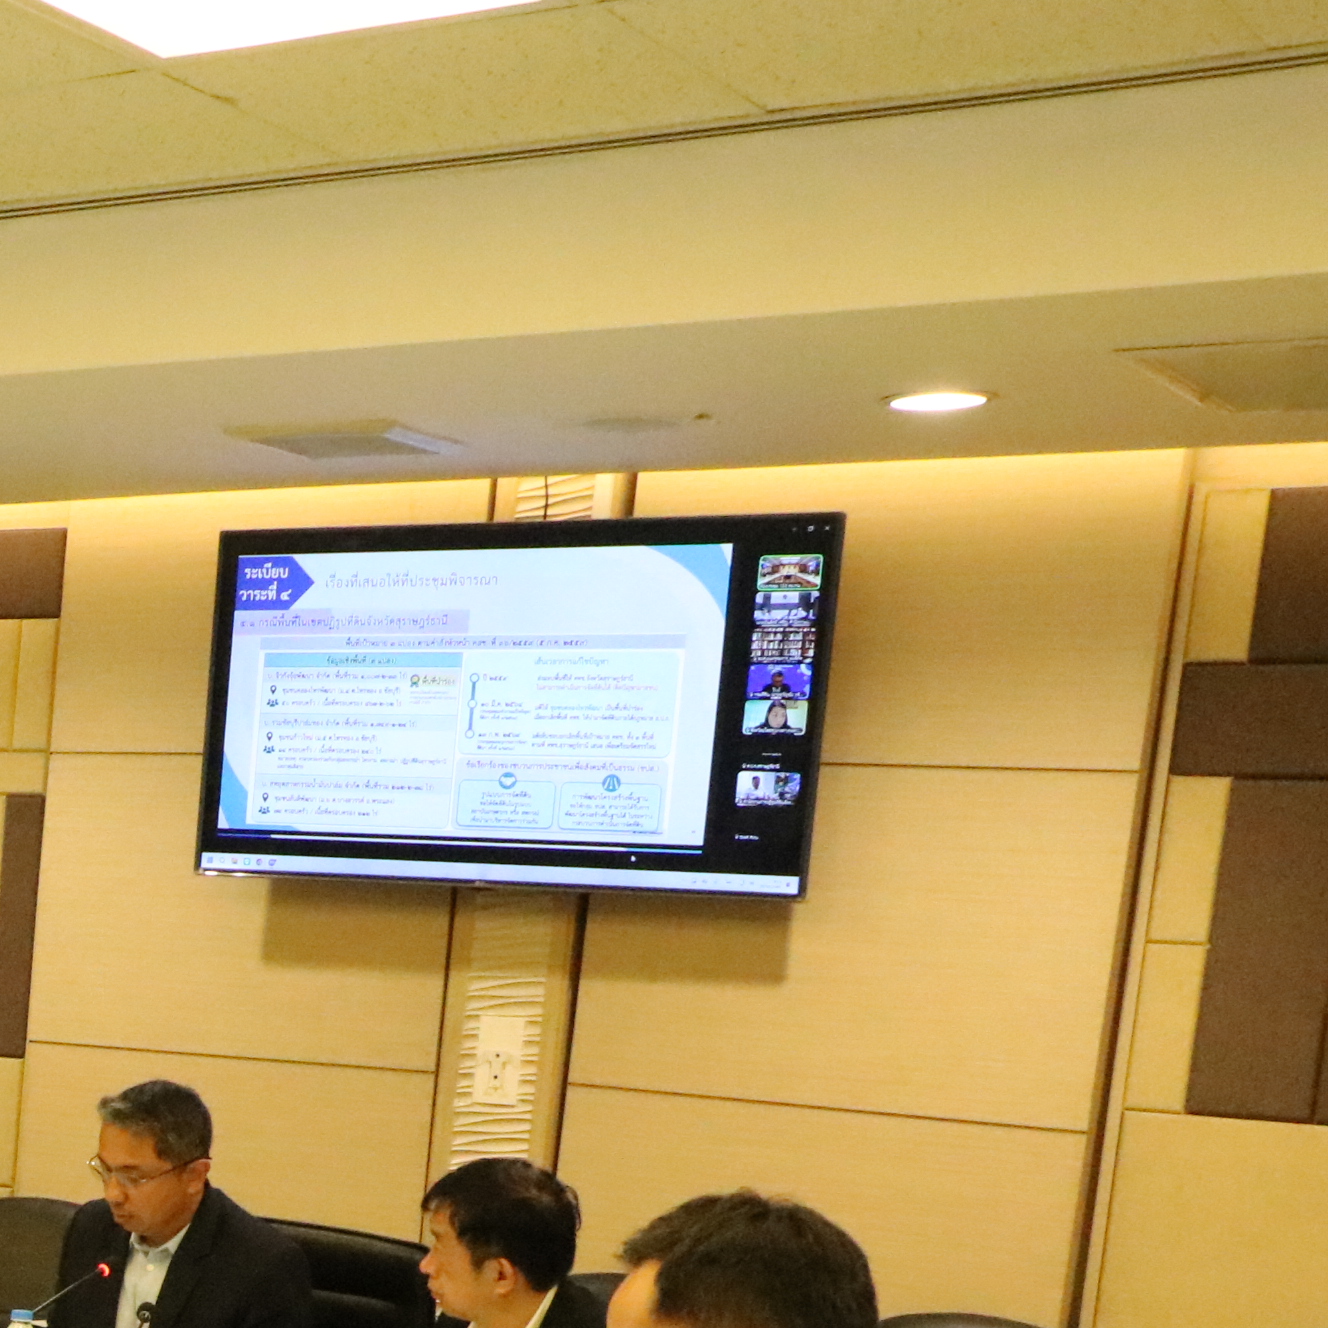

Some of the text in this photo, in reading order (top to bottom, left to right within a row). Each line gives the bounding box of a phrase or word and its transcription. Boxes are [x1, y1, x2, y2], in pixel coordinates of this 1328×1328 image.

[245, 563, 288, 579] ระเบียบ
[325, 571, 498, 590] เรื่องที่เสนอให้ที่ประชุมพิจารณา
[239, 582, 291, 600] วาระที่ ๔
